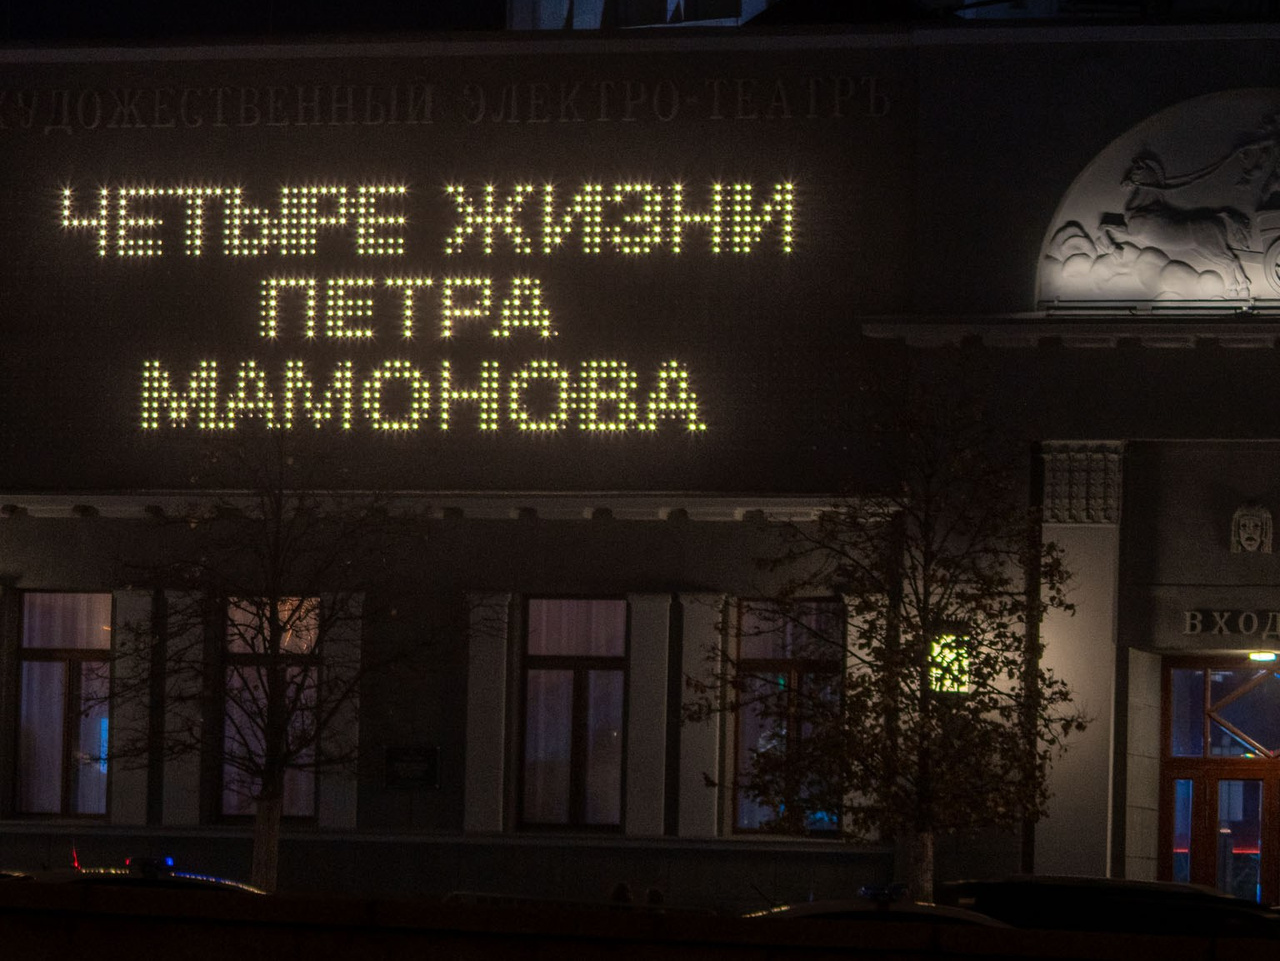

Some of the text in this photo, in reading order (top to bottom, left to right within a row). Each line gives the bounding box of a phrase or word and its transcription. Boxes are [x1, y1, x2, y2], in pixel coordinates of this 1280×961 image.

[58, 181, 796, 257] ЧЕТЫРЕ ЖИЗНИ
[258, 276, 559, 339] ПЕТРА
[141, 360, 708, 433] МАМОНОВА
